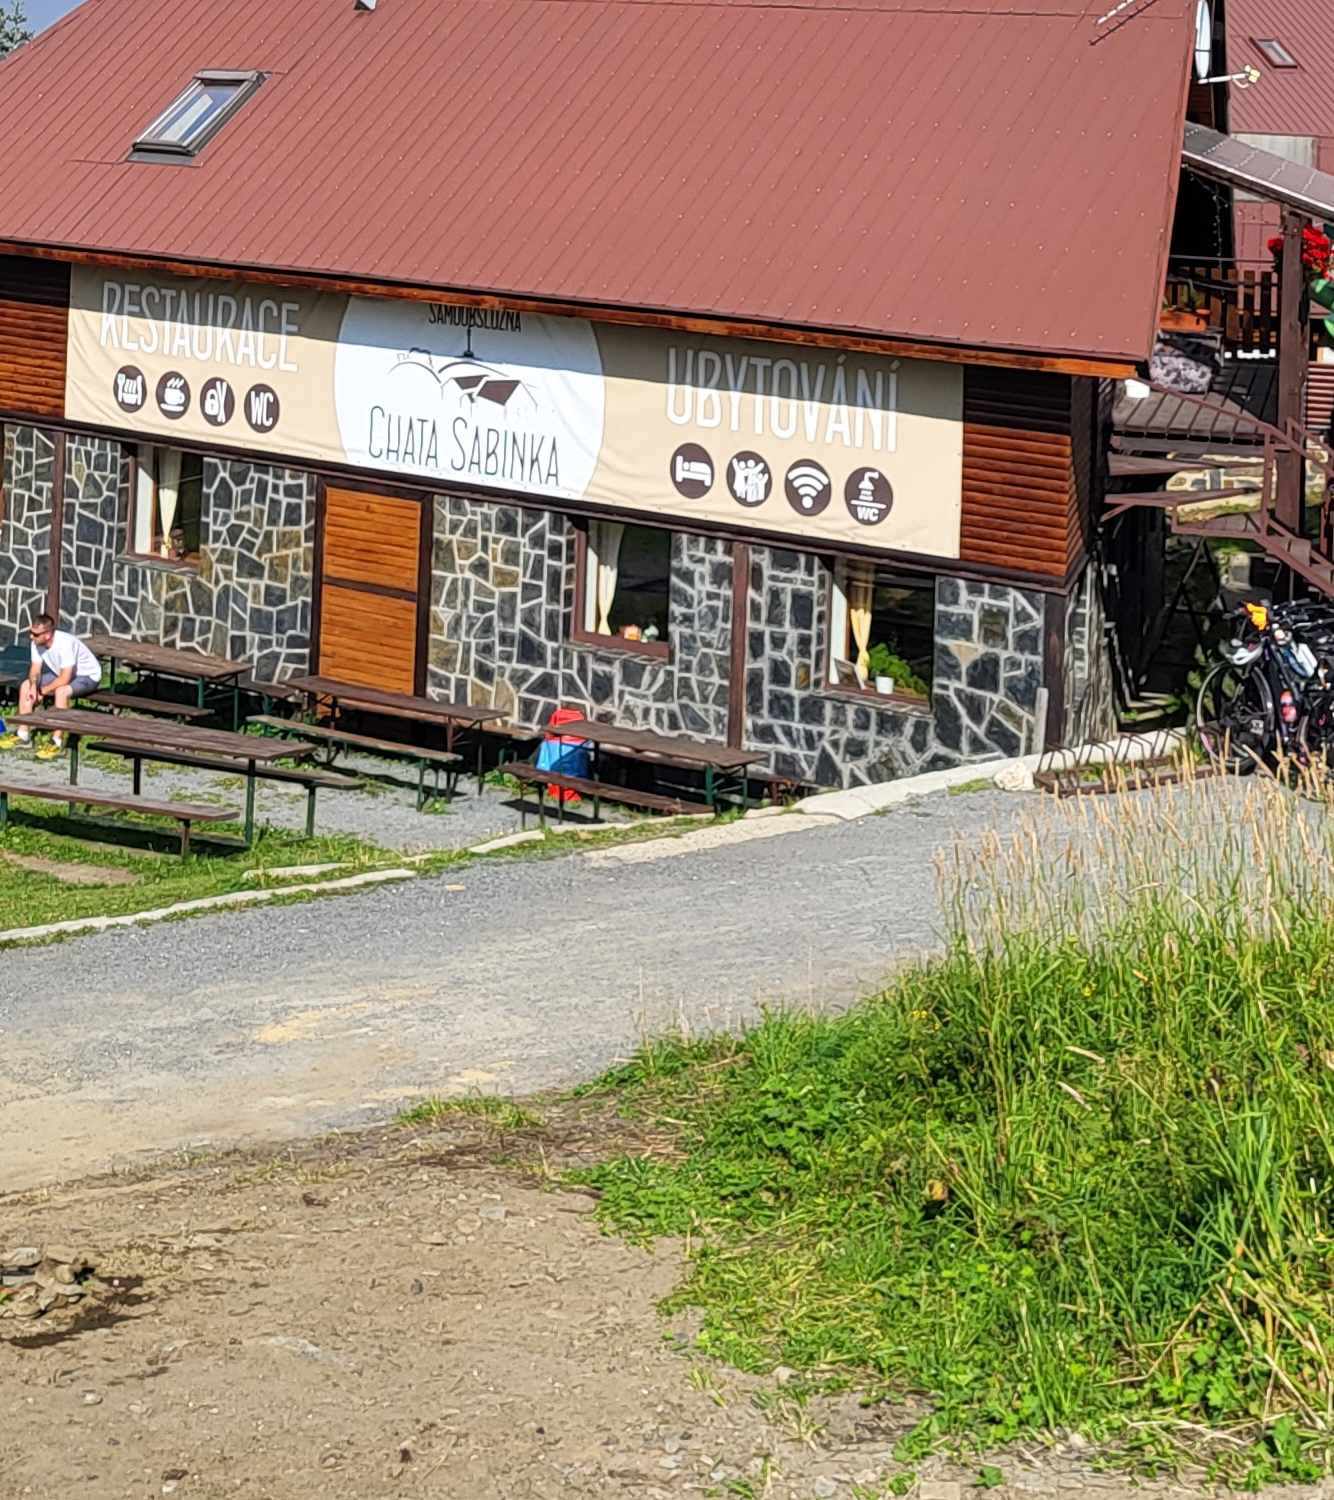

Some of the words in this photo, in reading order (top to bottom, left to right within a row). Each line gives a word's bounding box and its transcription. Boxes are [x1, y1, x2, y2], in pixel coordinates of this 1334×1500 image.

[100, 281, 300, 372] RESTAURACE
[250, 390, 274, 427] WC
[667, 347, 901, 453] UBYTOVÁNÍ
[368, 405, 438, 468] CHATA
[451, 416, 559, 487] SABINKA
[856, 505, 880, 522] WC
